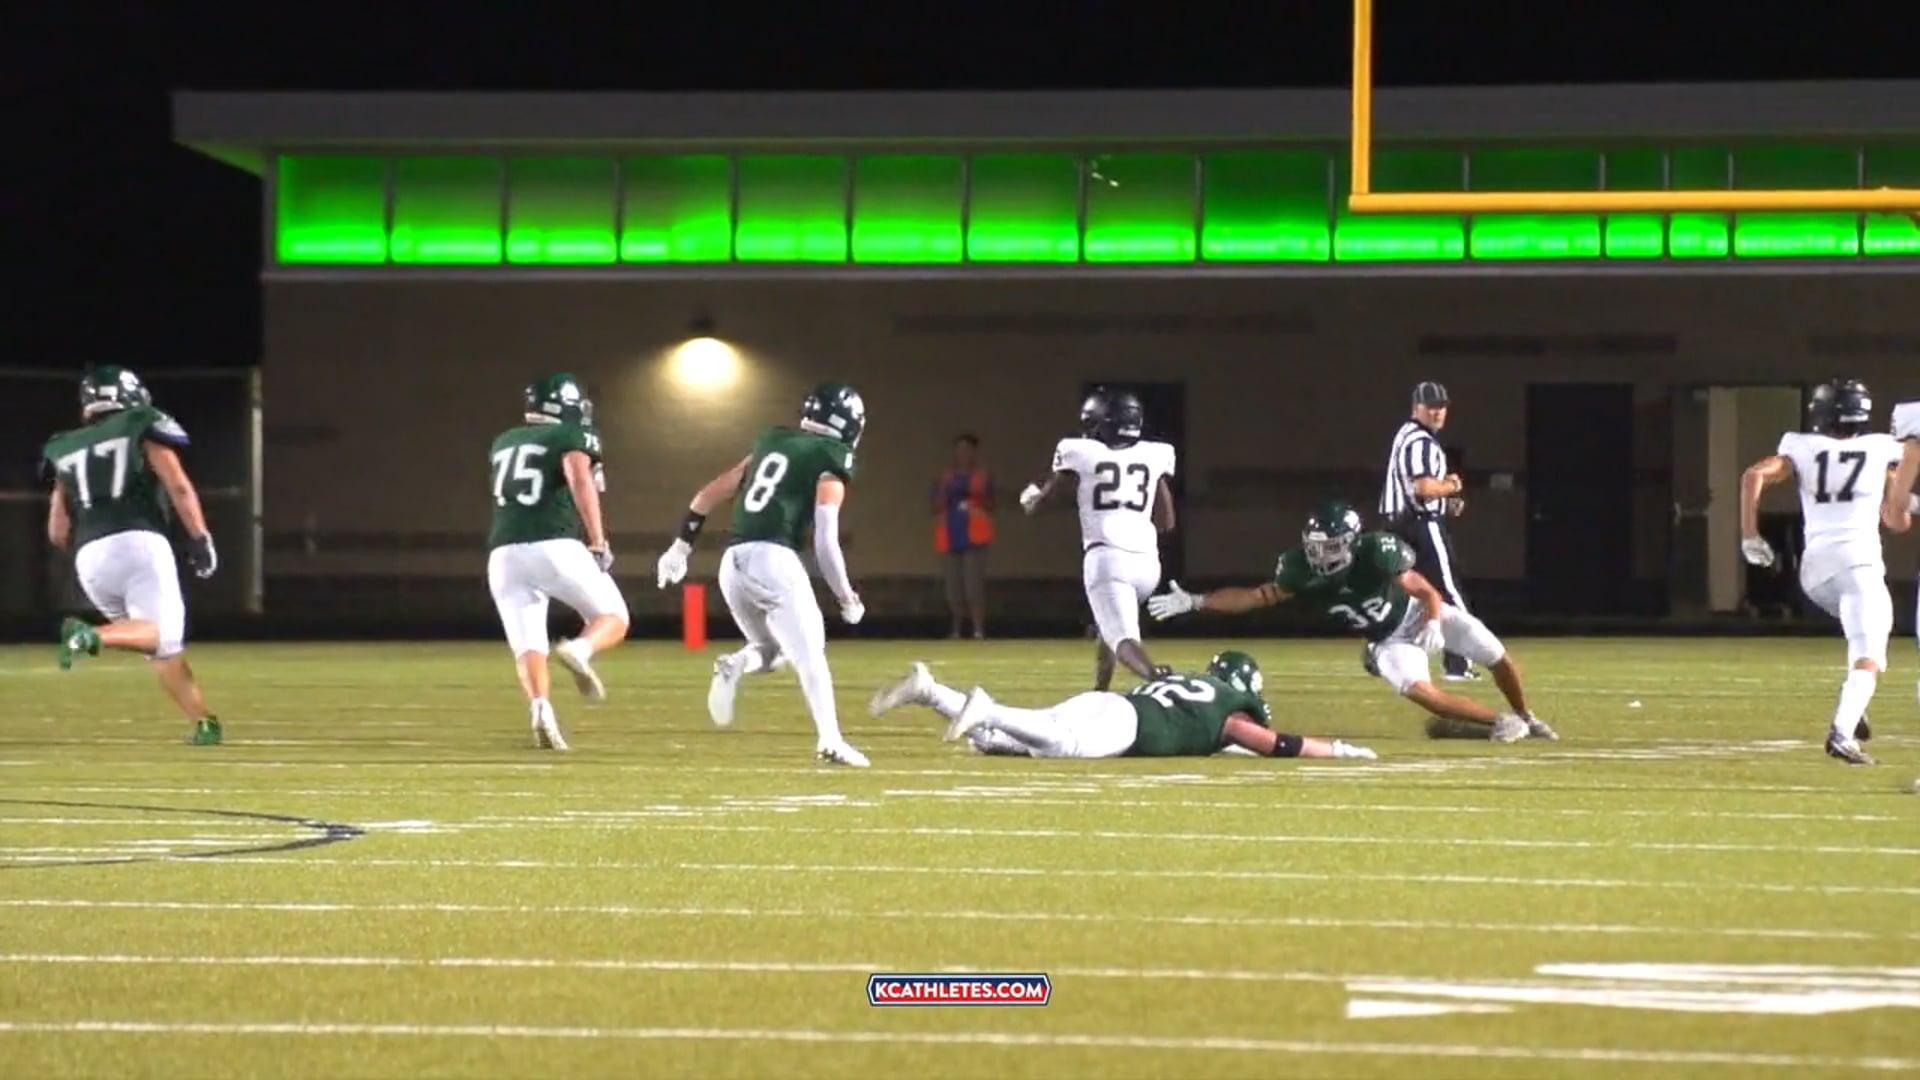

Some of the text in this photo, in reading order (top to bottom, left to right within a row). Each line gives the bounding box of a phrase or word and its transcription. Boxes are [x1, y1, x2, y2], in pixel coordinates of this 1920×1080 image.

[56, 436, 130, 508] 77
[493, 444, 548, 506] 75
[744, 452, 788, 512] 8
[1093, 461, 1150, 512] 23
[1815, 450, 1867, 503] 17
[1329, 597, 1392, 628] 32
